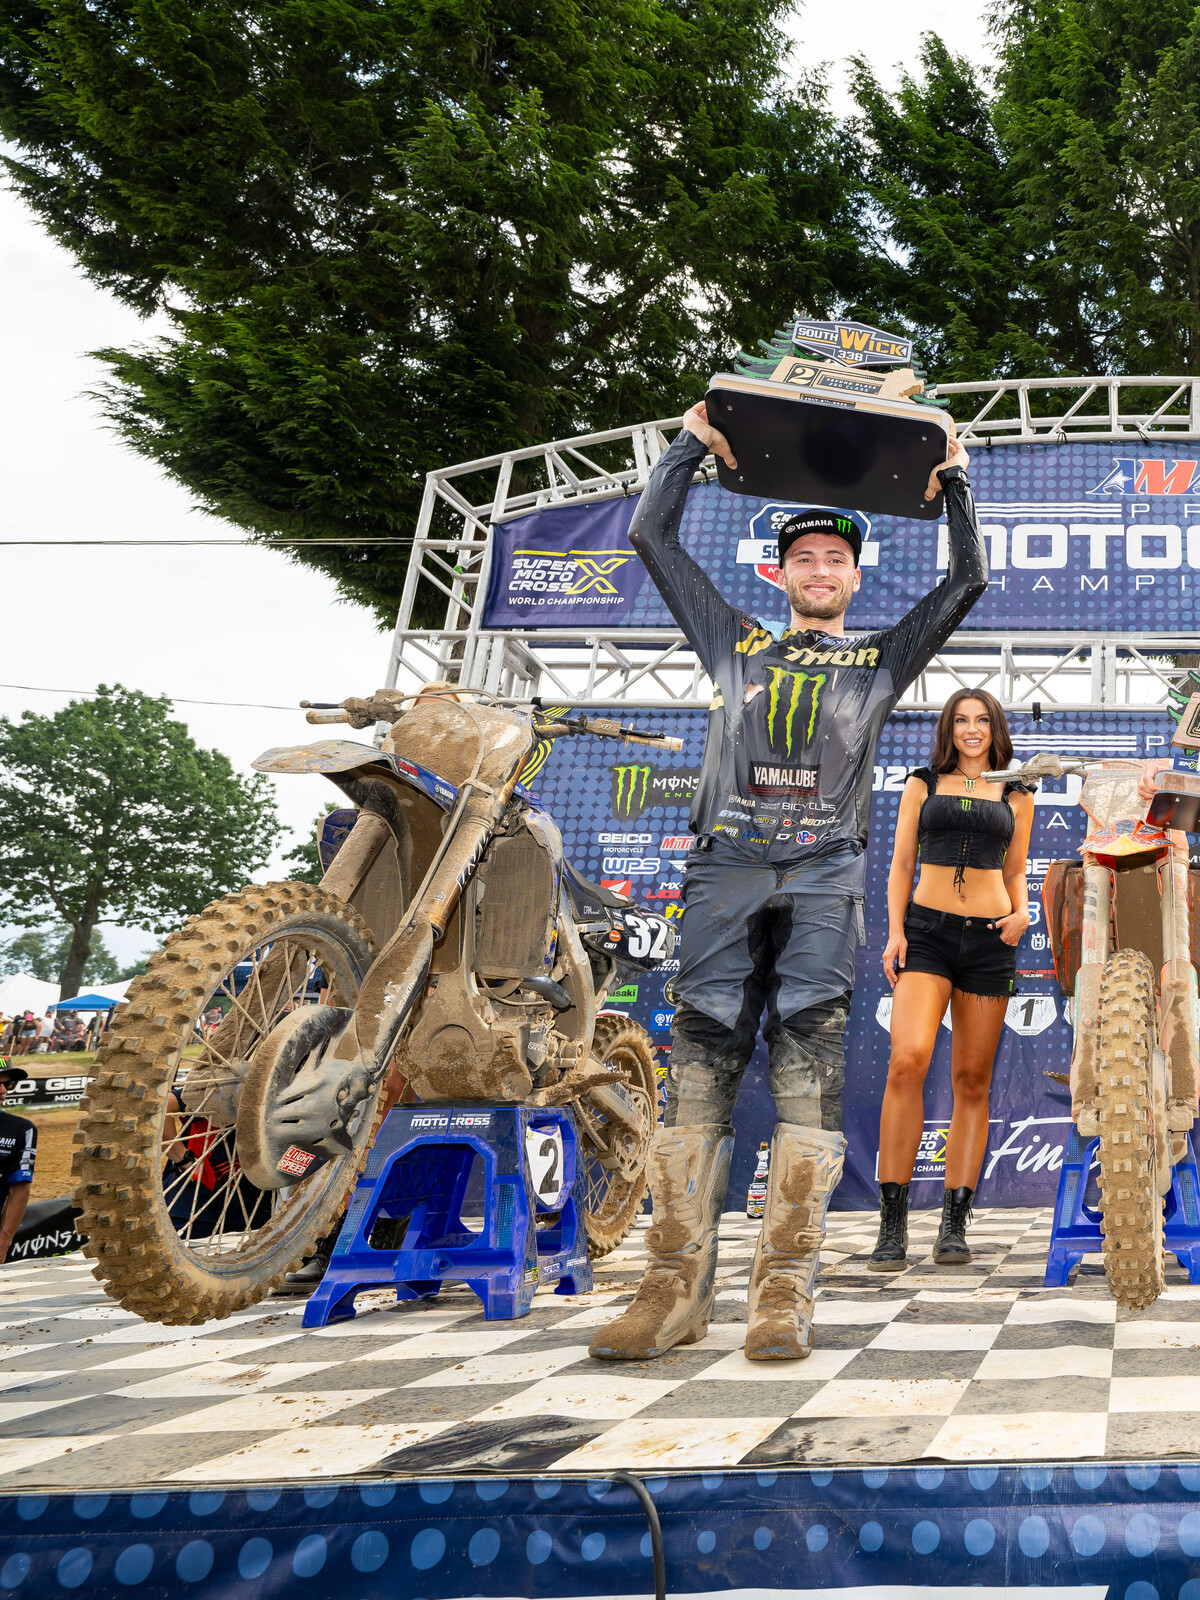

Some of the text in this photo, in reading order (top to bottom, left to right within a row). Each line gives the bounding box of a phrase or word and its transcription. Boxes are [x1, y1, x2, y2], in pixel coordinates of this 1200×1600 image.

[797, 327, 904, 357] SOUTH WICK
[837, 349, 863, 362] 338
[789, 366, 815, 385] 2
[795, 519, 834, 530] YAMAHA
[511, 558, 579, 571] SUPER
[513, 569, 574, 582] MOTO
[508, 581, 574, 592] CROSS
[508, 596, 625, 606] WORLD CHAMPIONSHIP
[784, 645, 880, 667] THOR
[753, 766, 818, 788] YAMALUBE
[781, 802, 836, 812] BICYCLES
[597, 833, 652, 844] GEICO
[603, 858, 660, 874] WPS
[625, 914, 668, 959] 32
[609, 989, 636, 997] asaki
[409, 1118, 491, 1127] MOTOCROSS
[285, 1148, 313, 1166] LIGHT
[280, 1159, 306, 1173] SPEED
[538, 1138, 560, 1195] 2
